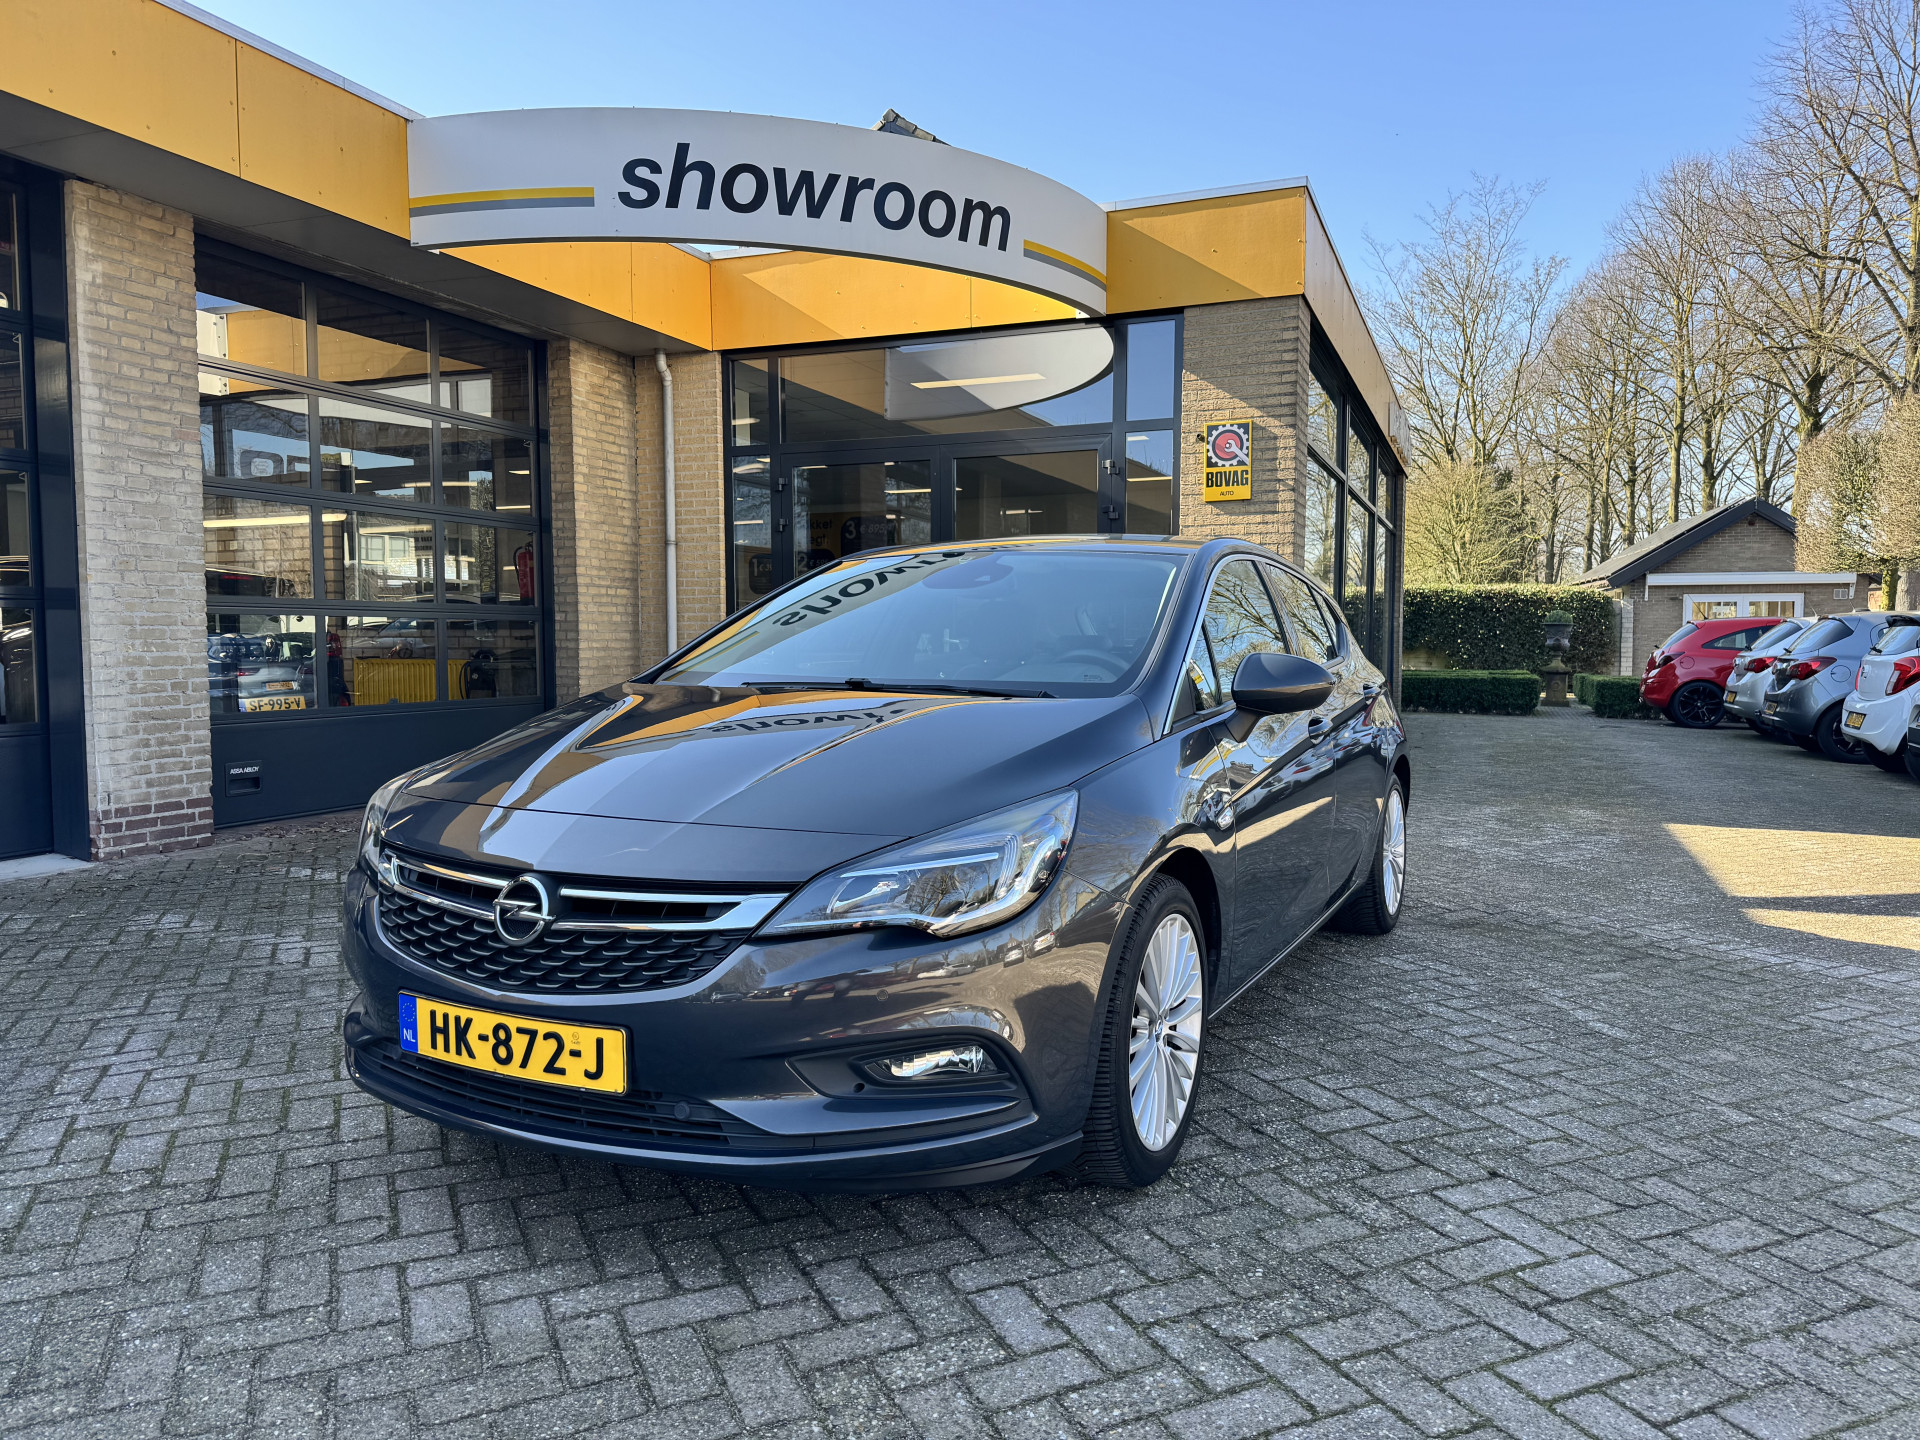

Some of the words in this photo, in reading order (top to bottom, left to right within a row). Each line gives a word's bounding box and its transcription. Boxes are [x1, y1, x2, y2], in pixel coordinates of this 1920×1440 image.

[617, 143, 1011, 252] showroom
[1206, 470, 1249, 488] BOVAG
[845, 520, 857, 540] 3
[249, 698, 301, 711] SF-995-V
[403, 1027, 416, 1043] NL
[429, 1009, 604, 1080] HK-872-J
